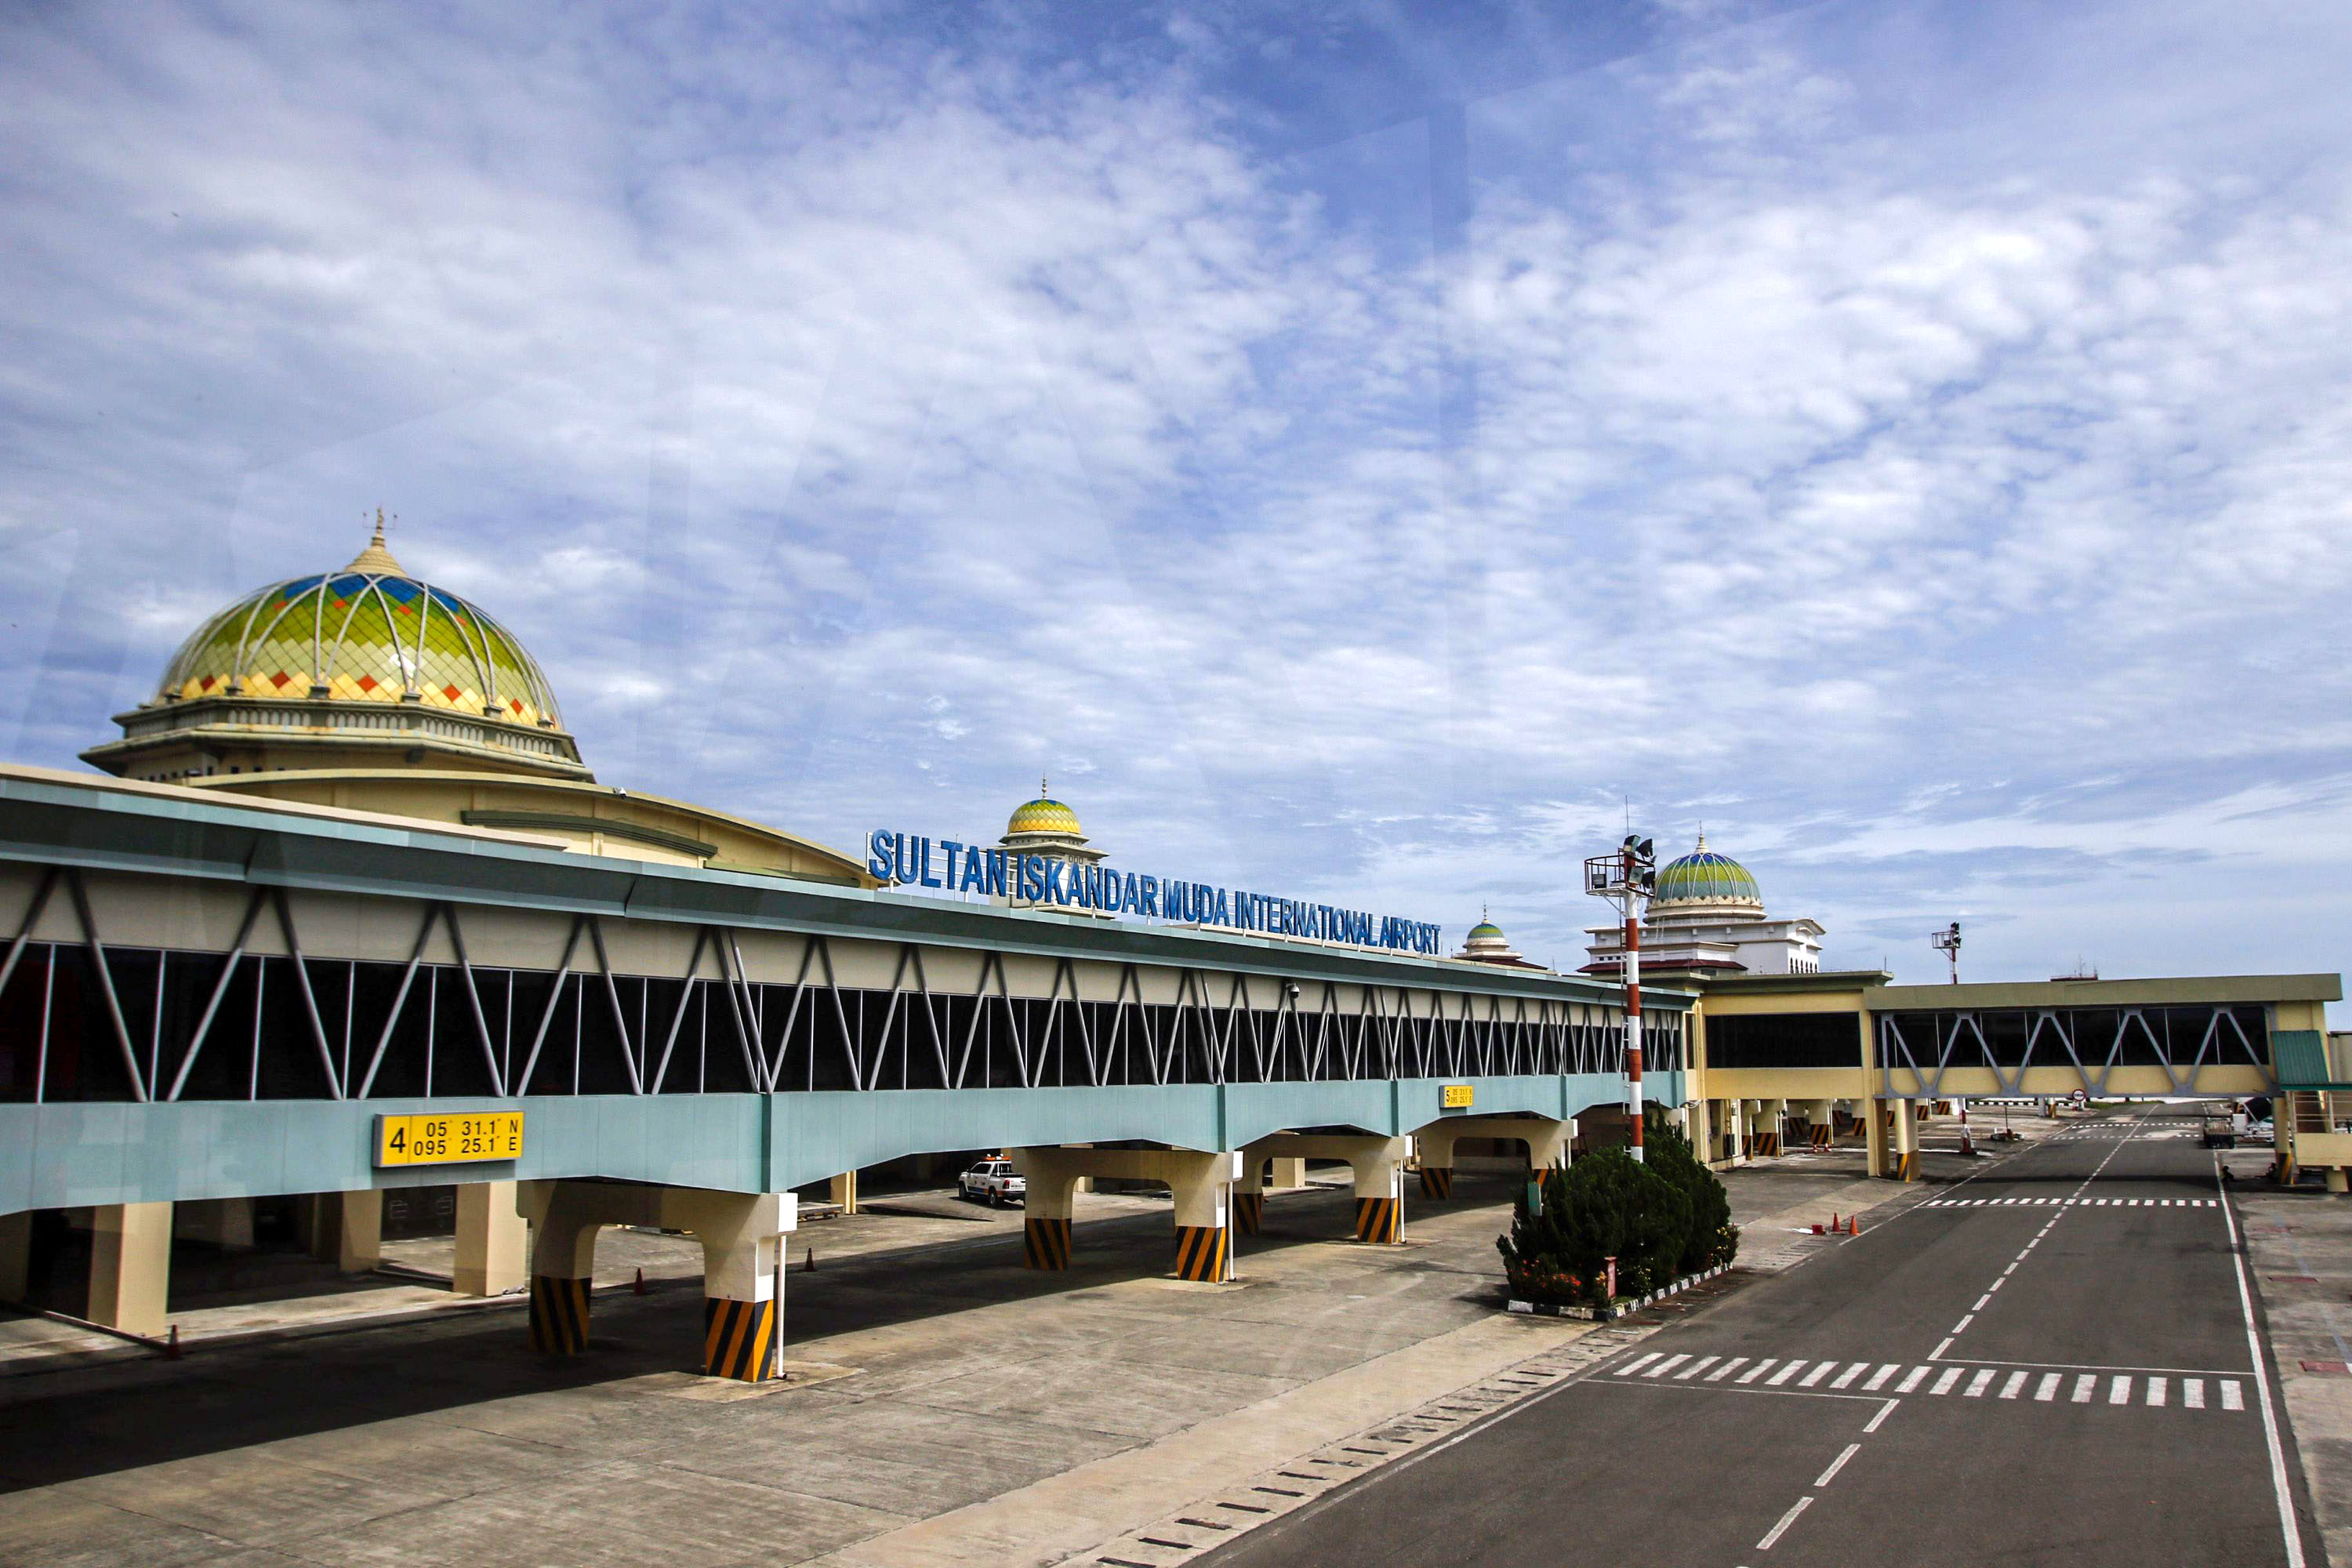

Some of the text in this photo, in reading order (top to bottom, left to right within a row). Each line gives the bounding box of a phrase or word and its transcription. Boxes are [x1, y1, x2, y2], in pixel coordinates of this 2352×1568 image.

[869, 829, 1441, 955] SULTAN ISKANDAR MUDA INTERNATIONAL AIRPORT
[1446, 1090, 1450, 1102] 5
[510, 1120, 518, 1134] N
[390, 1127, 406, 1153] 4
[509, 1137, 517, 1151] E
